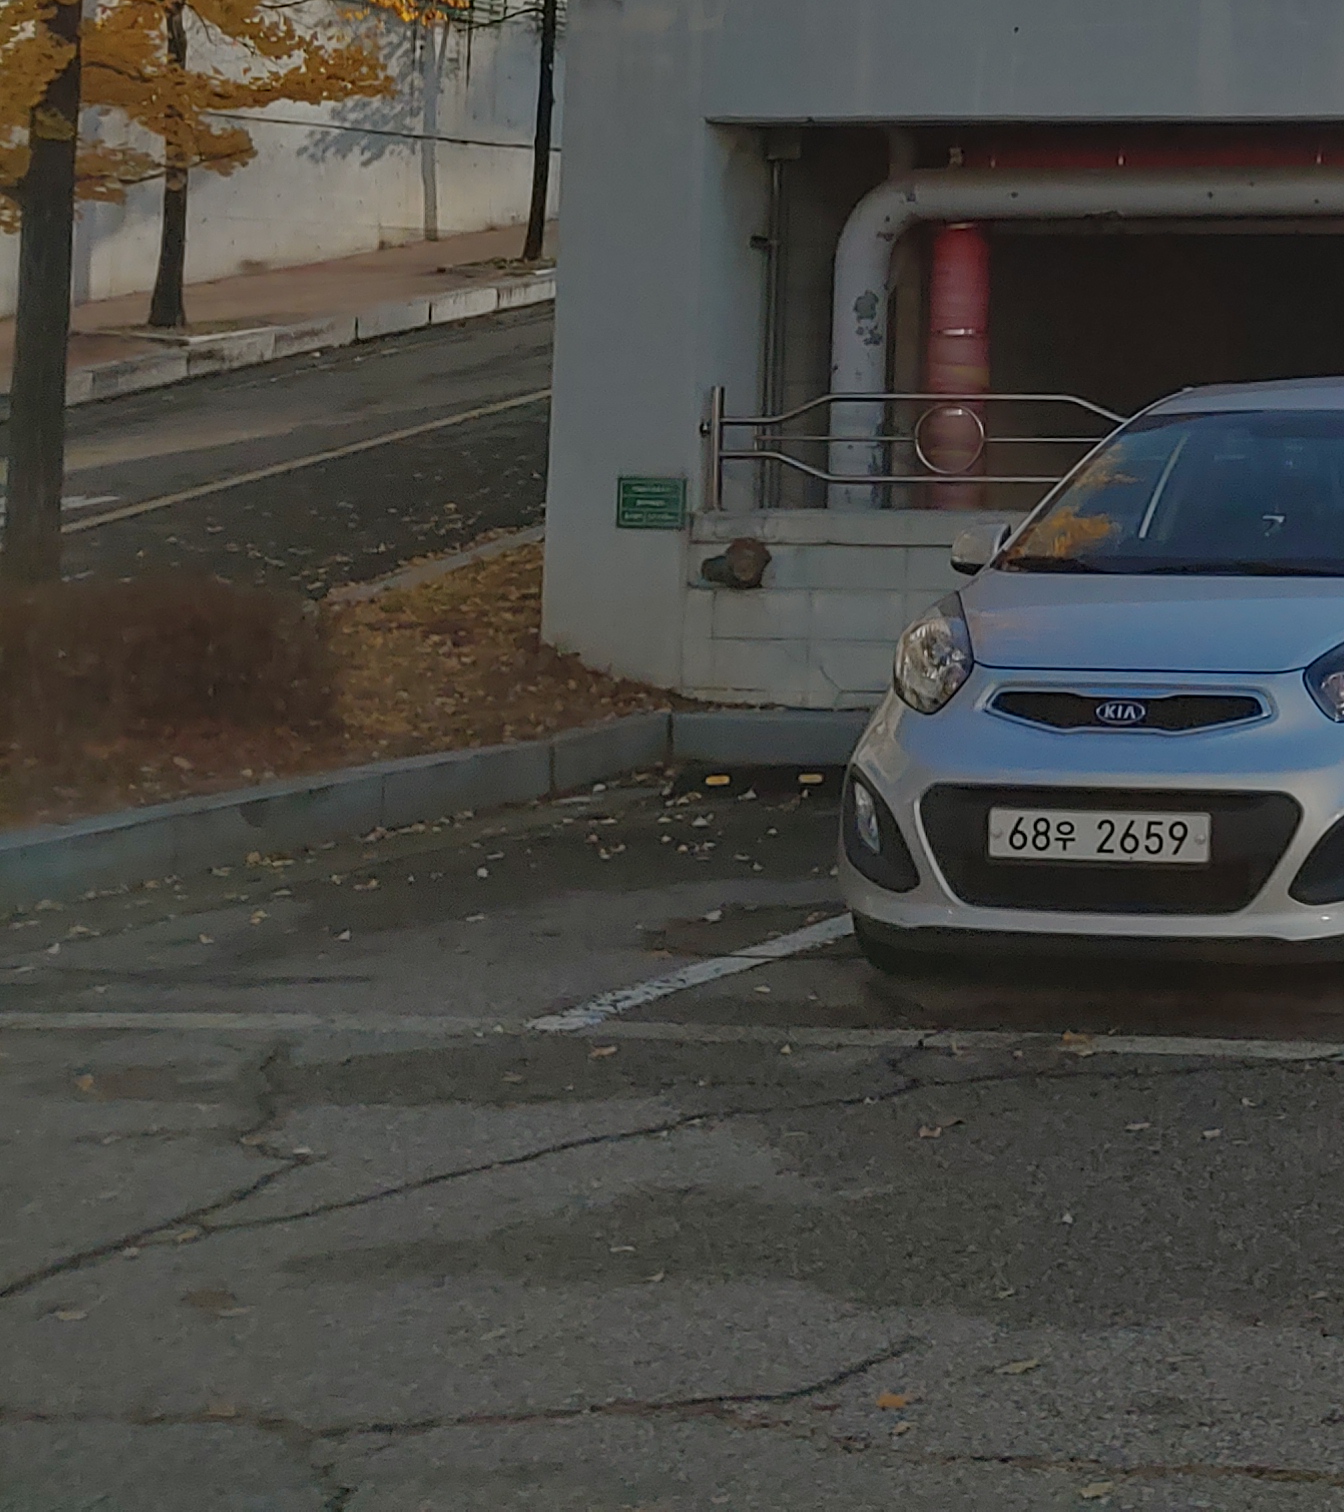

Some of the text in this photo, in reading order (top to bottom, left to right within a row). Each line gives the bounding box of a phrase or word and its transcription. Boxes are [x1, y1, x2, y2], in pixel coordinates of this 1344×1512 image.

[1104, 705, 1136, 719] KIA
[1008, 816, 1188, 855] 68우 2659
